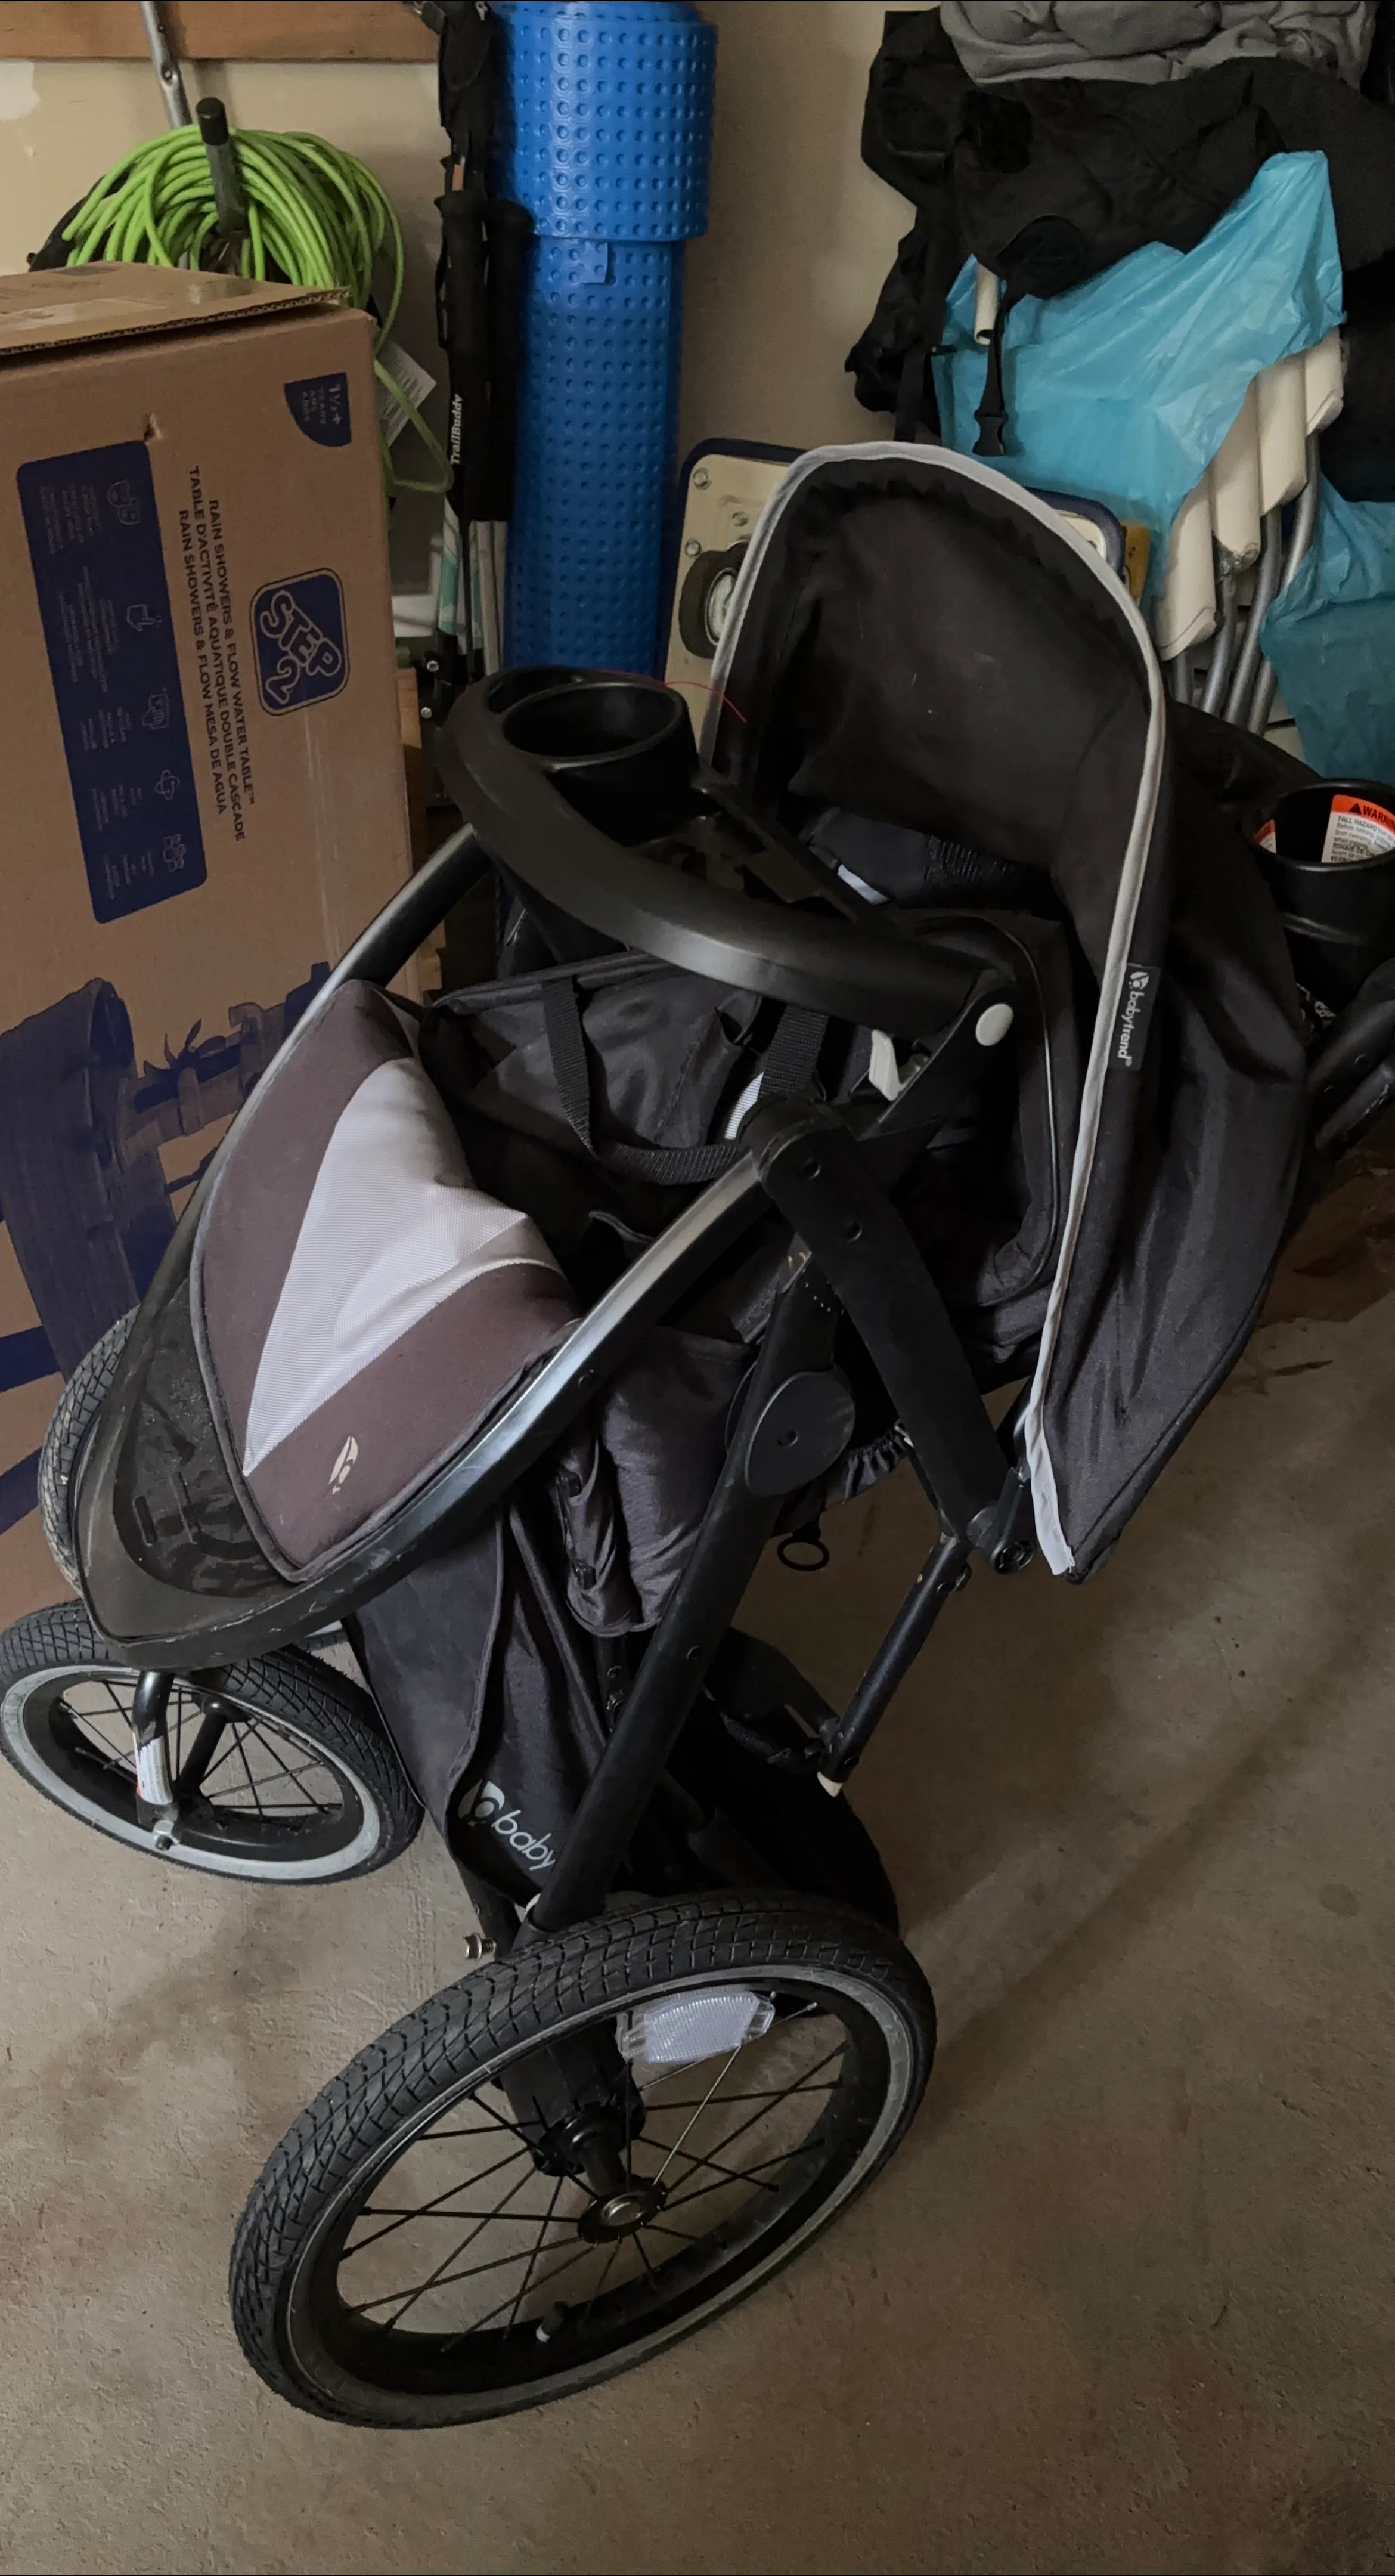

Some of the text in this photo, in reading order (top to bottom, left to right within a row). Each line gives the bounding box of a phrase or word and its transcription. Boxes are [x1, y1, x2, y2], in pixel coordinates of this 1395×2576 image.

[450, 393, 464, 465] TrailBuddy
[209, 499, 222, 540] RAIN
[214, 543, 233, 624] SHOWERS
[189, 465, 246, 842] TABLE D'ACTIVITÉ AQUATIQUE DOUBLE CASCADE
[224, 628, 234, 639] &
[259, 590, 342, 677] STEP
[179, 509, 227, 816] RAIN SHOWERS & FLOW MESA DE AGUA
[227, 642, 241, 688] FLOW
[265, 655, 300, 704] 2
[232, 691, 247, 745] WATER
[1363, 805, 1395, 831] WARNIN
